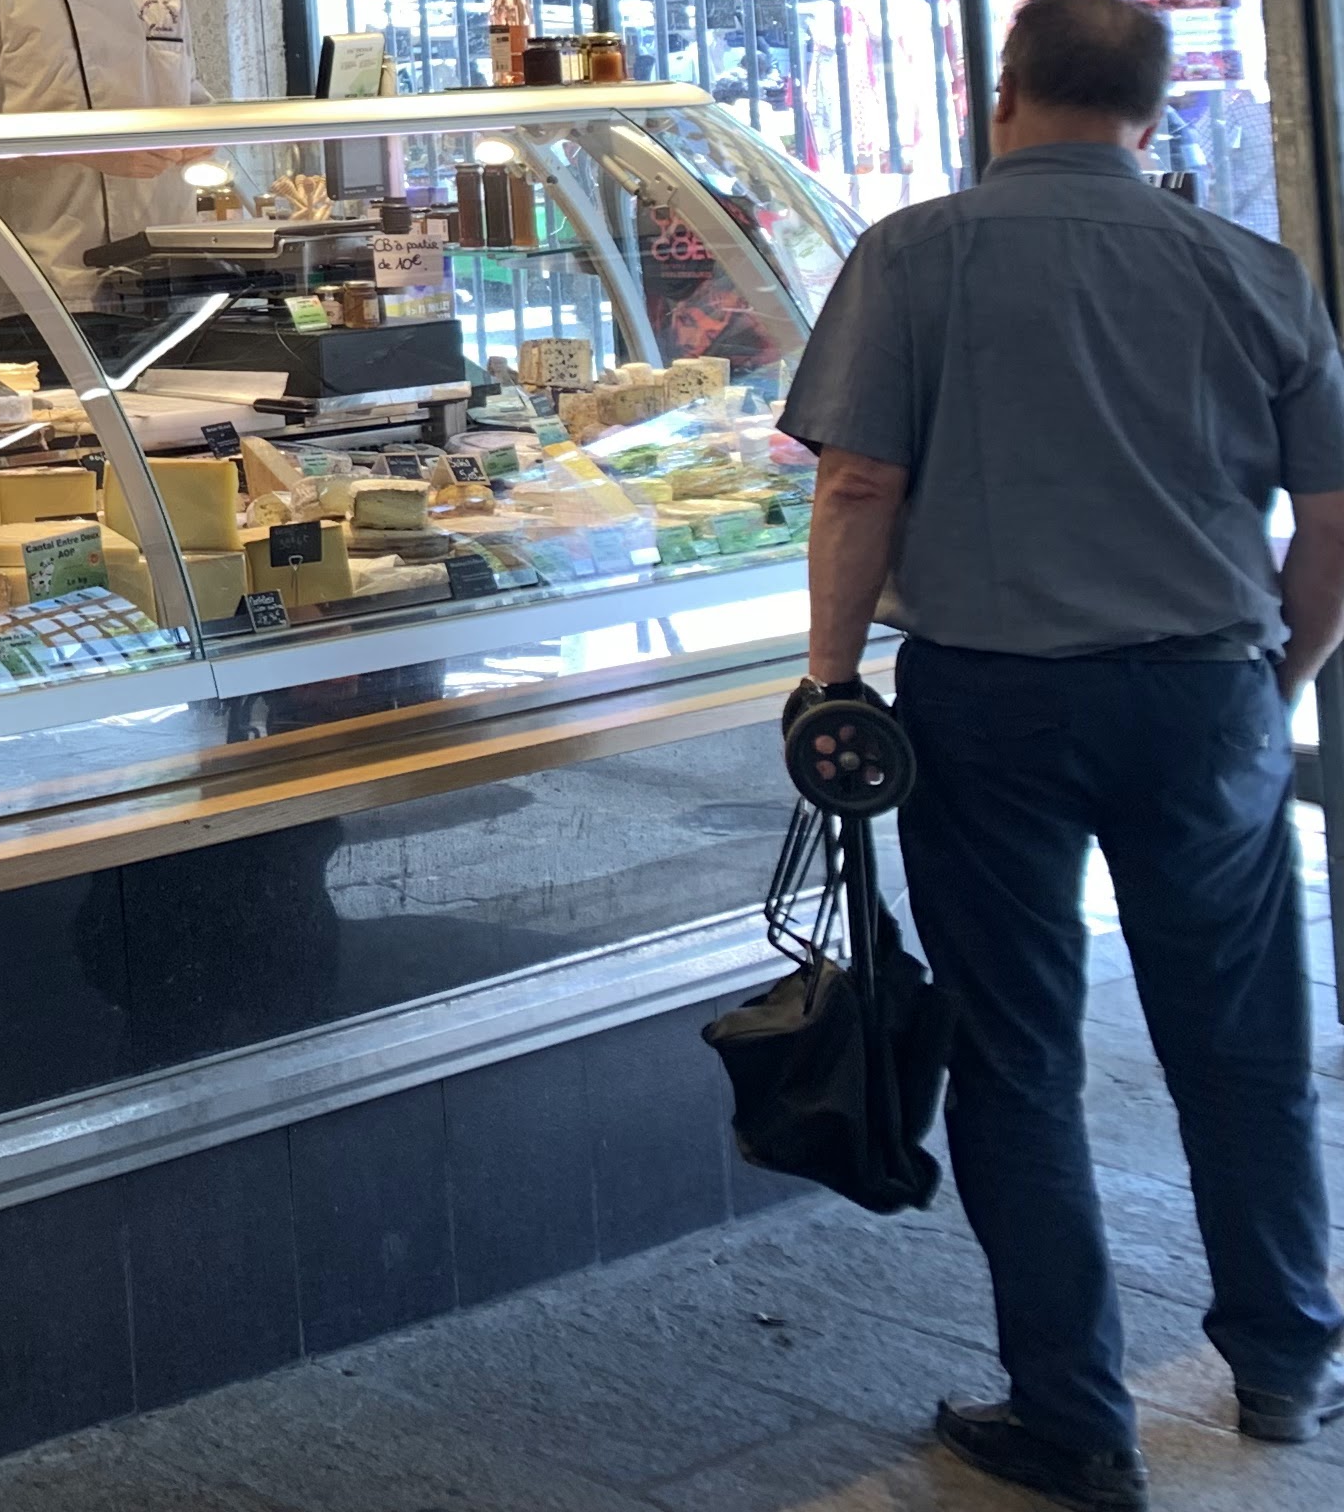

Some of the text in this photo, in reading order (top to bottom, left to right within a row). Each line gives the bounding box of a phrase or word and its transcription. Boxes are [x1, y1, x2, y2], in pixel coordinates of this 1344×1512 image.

[374, 238, 393, 252] CB
[378, 258, 392, 270] de
[25, 540, 55, 554] Cantal
[56, 536, 79, 548] Entre
[57, 548, 76, 560] AOP
